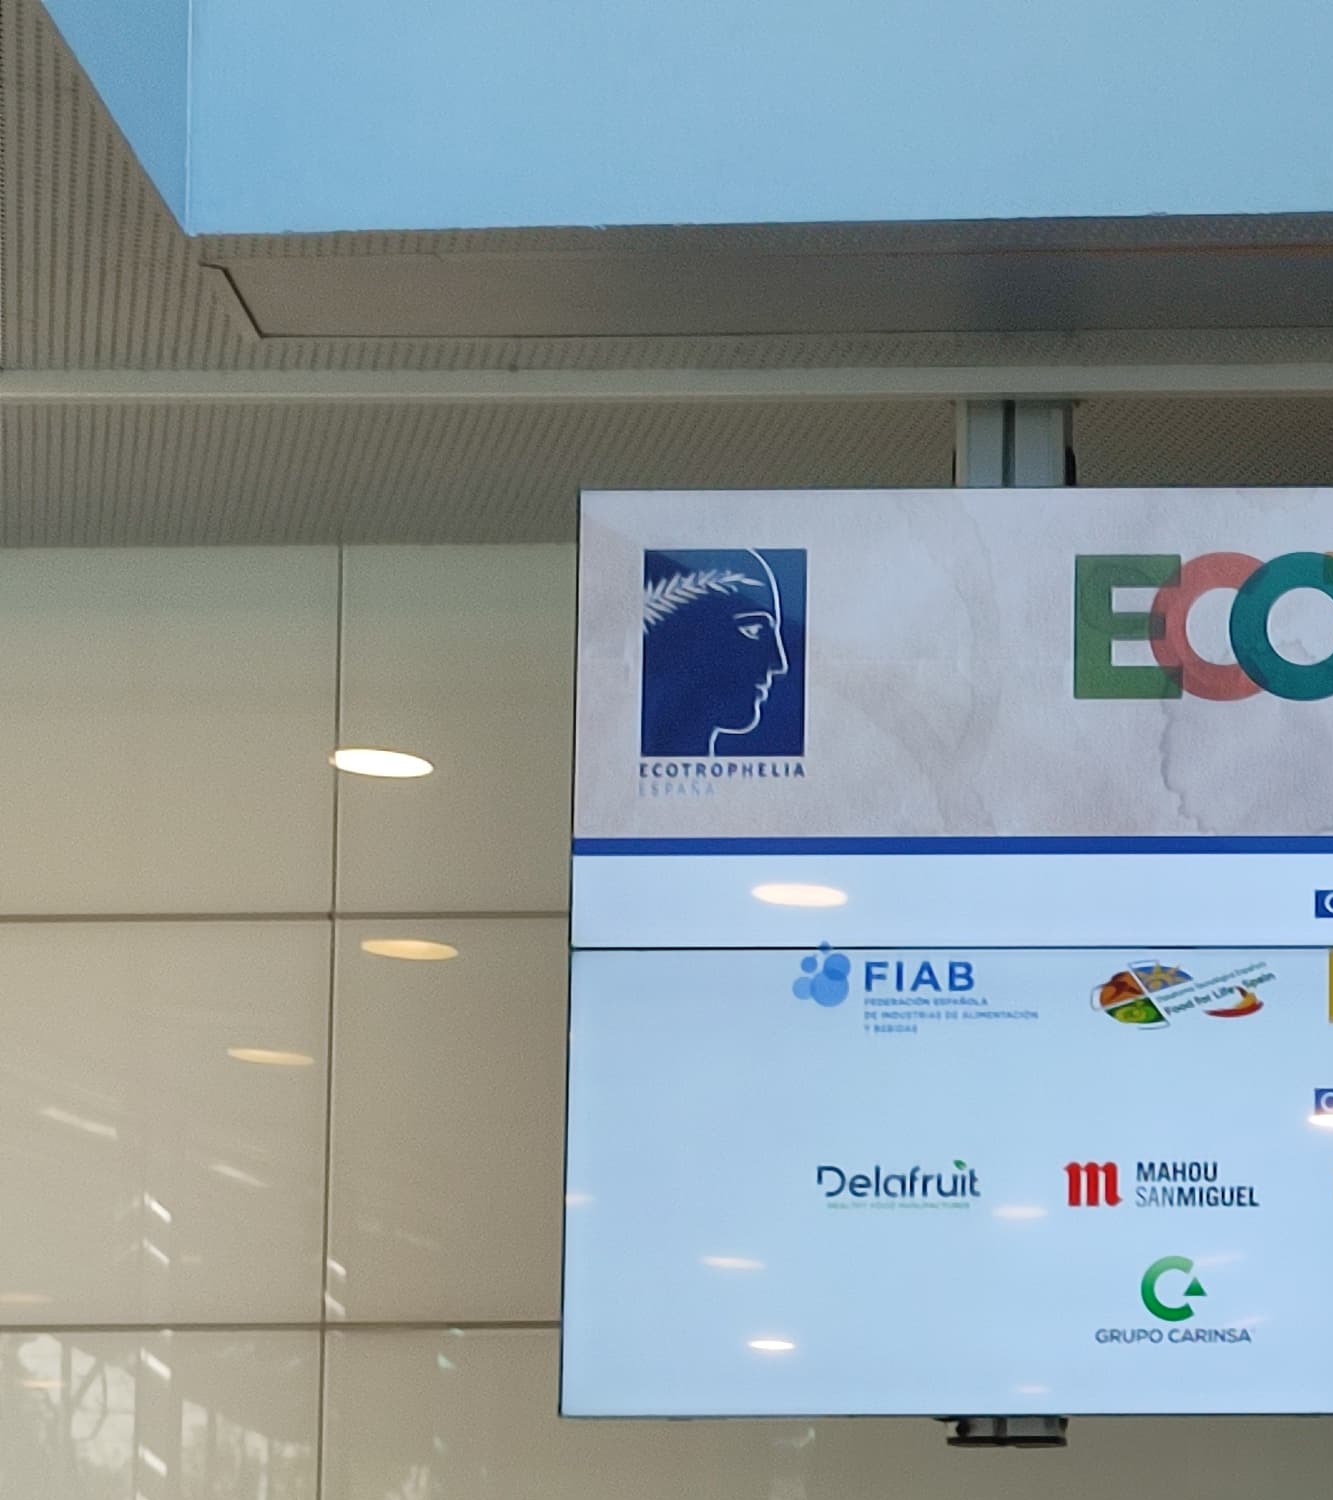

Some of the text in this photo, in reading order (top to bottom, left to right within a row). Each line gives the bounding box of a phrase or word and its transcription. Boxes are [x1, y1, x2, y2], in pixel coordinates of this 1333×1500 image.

[639, 763, 805, 778] ECOTROPHELIA
[639, 779, 715, 797] ESPAÑA
[865, 961, 975, 992] FIAB
[817, 1161, 981, 1197] Delafruit
[1136, 1161, 1218, 1182] MAHOU
[1095, 1328, 1252, 1344] GRUPO CARINSA
